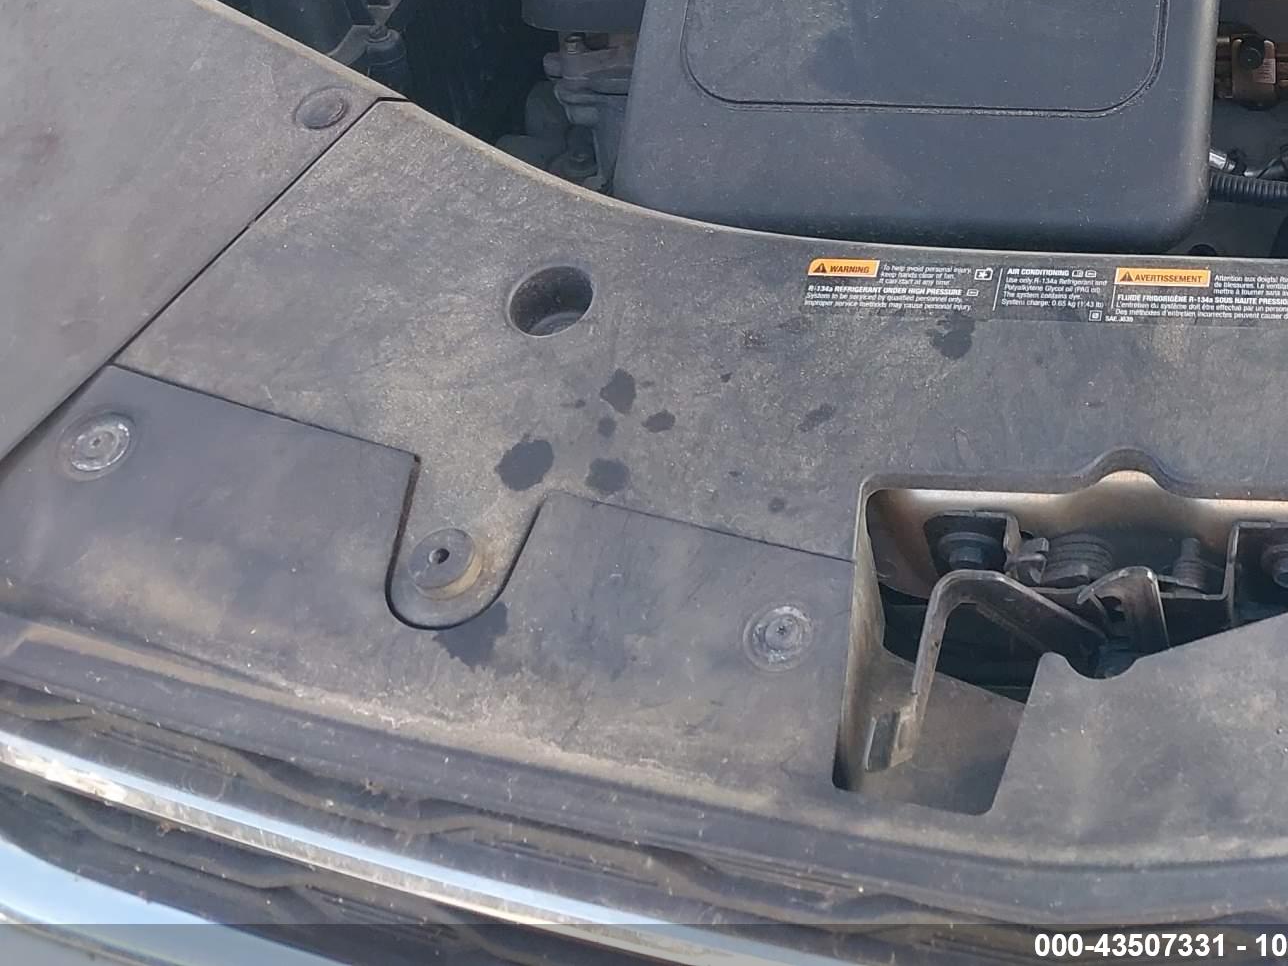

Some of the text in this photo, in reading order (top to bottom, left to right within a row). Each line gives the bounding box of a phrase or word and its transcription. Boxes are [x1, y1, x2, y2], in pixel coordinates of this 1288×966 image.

[829, 265, 870, 274] WARNING
[1006, 268, 1070, 277] AIR CONDITIONING
[1134, 273, 1203, 283] AVERTISSEMENT
[807, 285, 833, 293] R-134a
[834, 286, 882, 294] REFRIGERANT
[907, 287, 926, 295] HIGH
[926, 288, 963, 296] PRESSURE
[1117, 294, 1141, 302] FLUIDE
[1188, 296, 1213, 304] R-134a
[1214, 296, 1234, 304] SOUS
[1234, 297, 1257, 305] HAUTE
